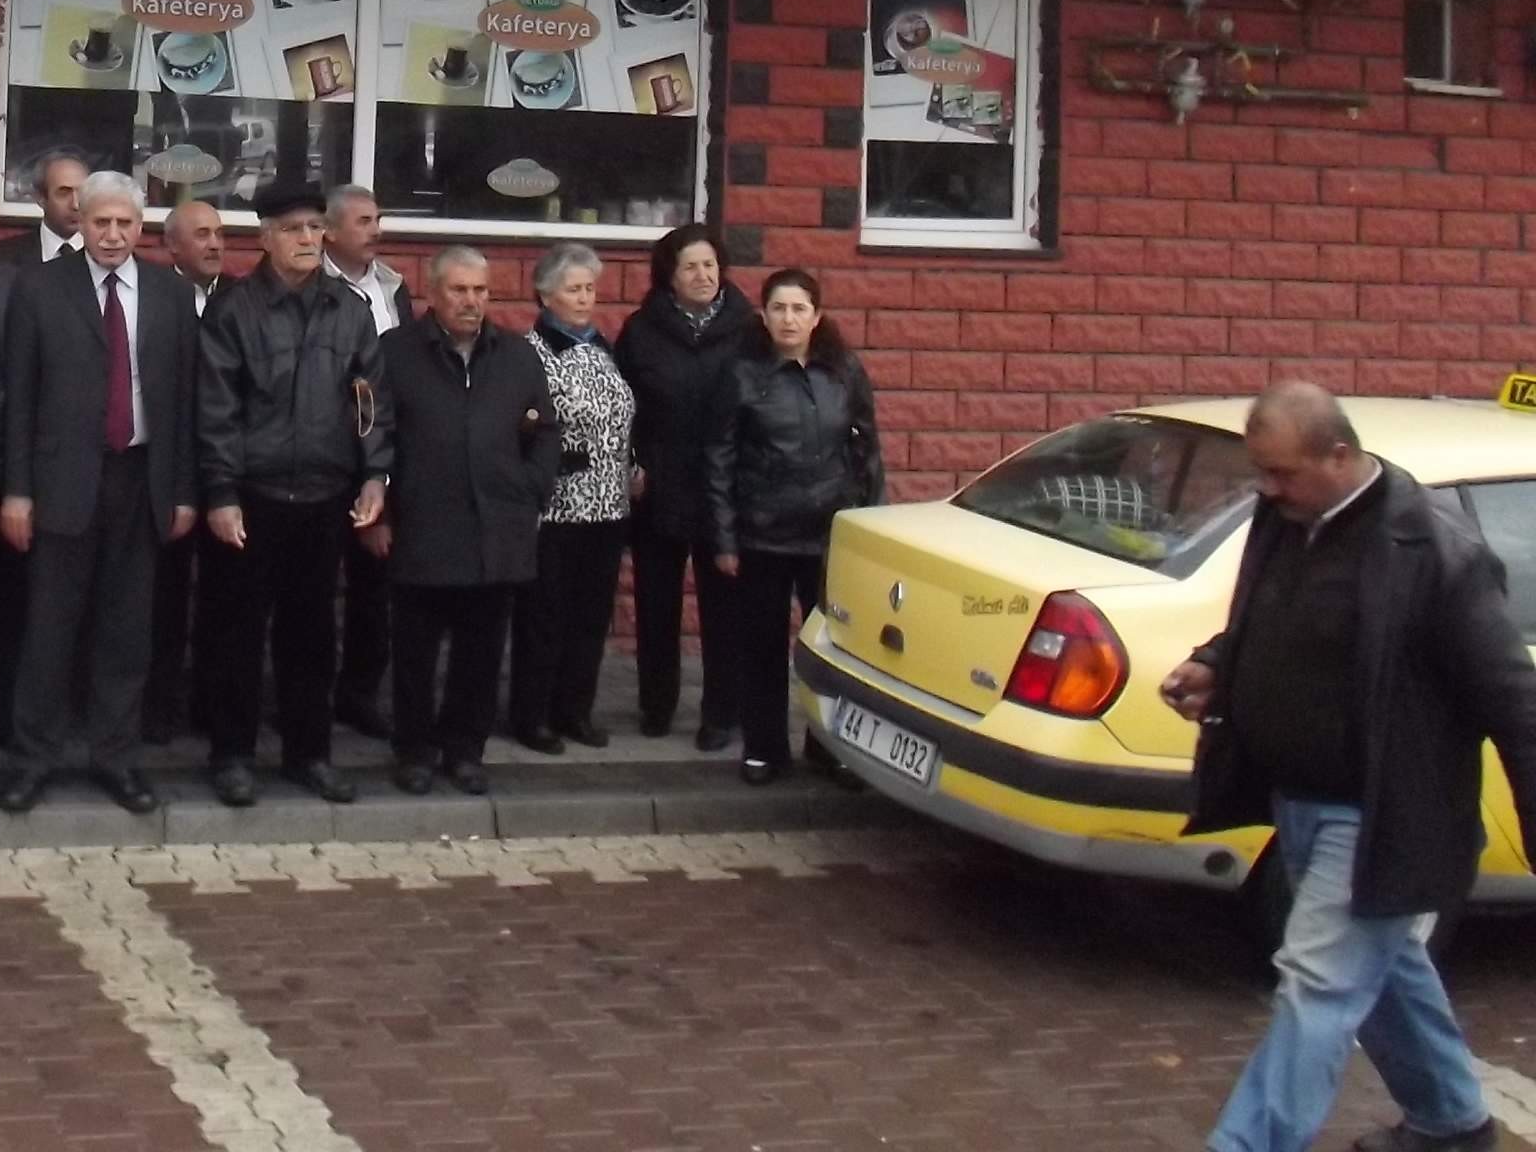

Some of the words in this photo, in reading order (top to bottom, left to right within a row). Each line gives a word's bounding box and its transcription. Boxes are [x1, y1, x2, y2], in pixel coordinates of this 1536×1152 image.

[486, 13, 591, 40] Kafeterya
[906, 55, 982, 74] Kafeterya
[845, 708, 864, 741] 44
[869, 719, 881, 749] T
[889, 733, 928, 775] 0132
